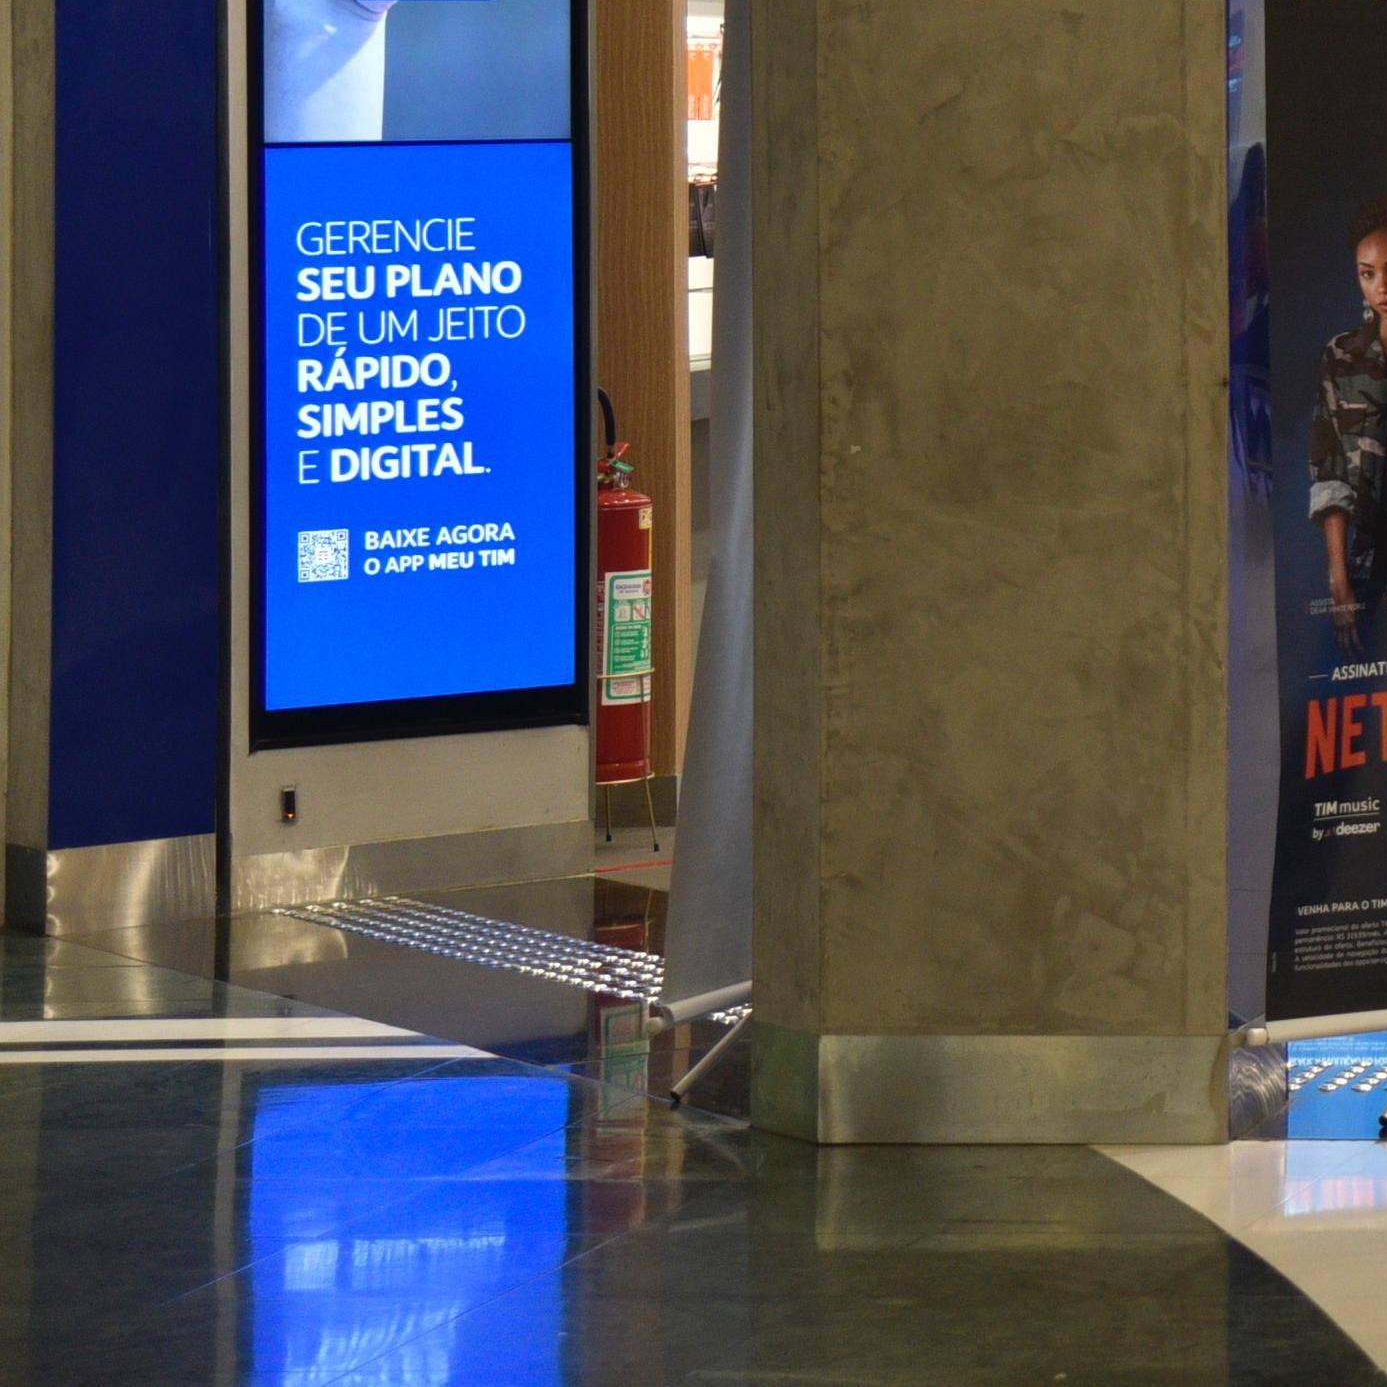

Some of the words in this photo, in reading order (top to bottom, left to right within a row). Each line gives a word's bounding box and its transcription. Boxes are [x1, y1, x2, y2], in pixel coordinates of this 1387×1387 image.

[296, 217, 475, 256] GERENCIE
[297, 265, 375, 301] SEU
[386, 261, 522, 298] PLANO
[297, 312, 347, 347] DE
[358, 309, 418, 344] UM
[428, 305, 526, 343] JEITO
[297, 347, 458, 393] RÁPIDO,
[297, 396, 464, 438] SIMPLES
[298, 450, 319, 484] E
[330, 441, 492, 483] DIGITAL.
[364, 528, 430, 550] BAIXE
[436, 522, 515, 546] AGORA
[364, 558, 380, 576] O
[385, 555, 424, 574] APP
[429, 552, 473, 570] MEU
[478, 549, 515, 568] TIM
[1314, 801, 1338, 817] TIM
[1339, 797, 1380, 813] music
[1312, 827, 1324, 841] by
[1335, 821, 1381, 836] deezer
[1297, 904, 1330, 915] VENHA
[1331, 901, 1359, 912] PARA
[1361, 900, 1369, 910] O
